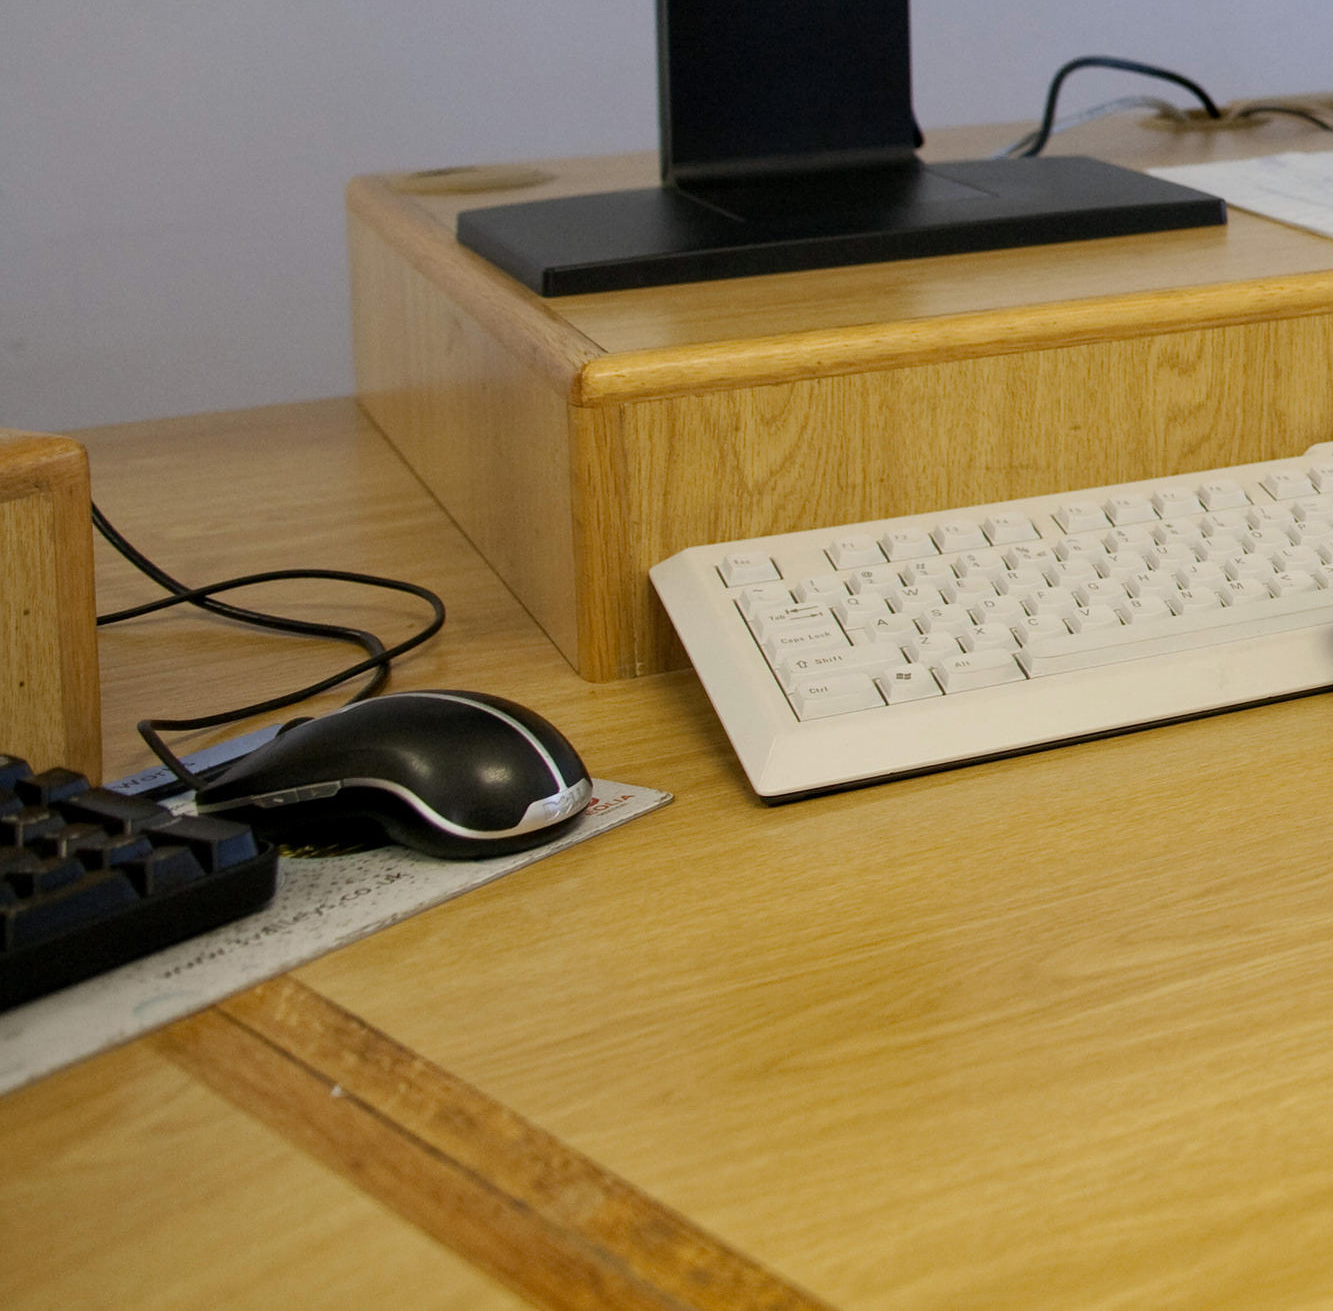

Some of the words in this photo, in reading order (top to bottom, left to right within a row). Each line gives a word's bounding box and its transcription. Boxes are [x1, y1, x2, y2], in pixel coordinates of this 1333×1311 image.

[903, 588, 919, 597] W
[848, 598, 859, 607] Q
[877, 619, 889, 627] A
[781, 637, 804, 646] Caps
[808, 631, 831, 641] Lock
[815, 654, 843, 666] Shift
[809, 686, 829, 695] Ctrl
[113, 761, 196, 789] Wors
